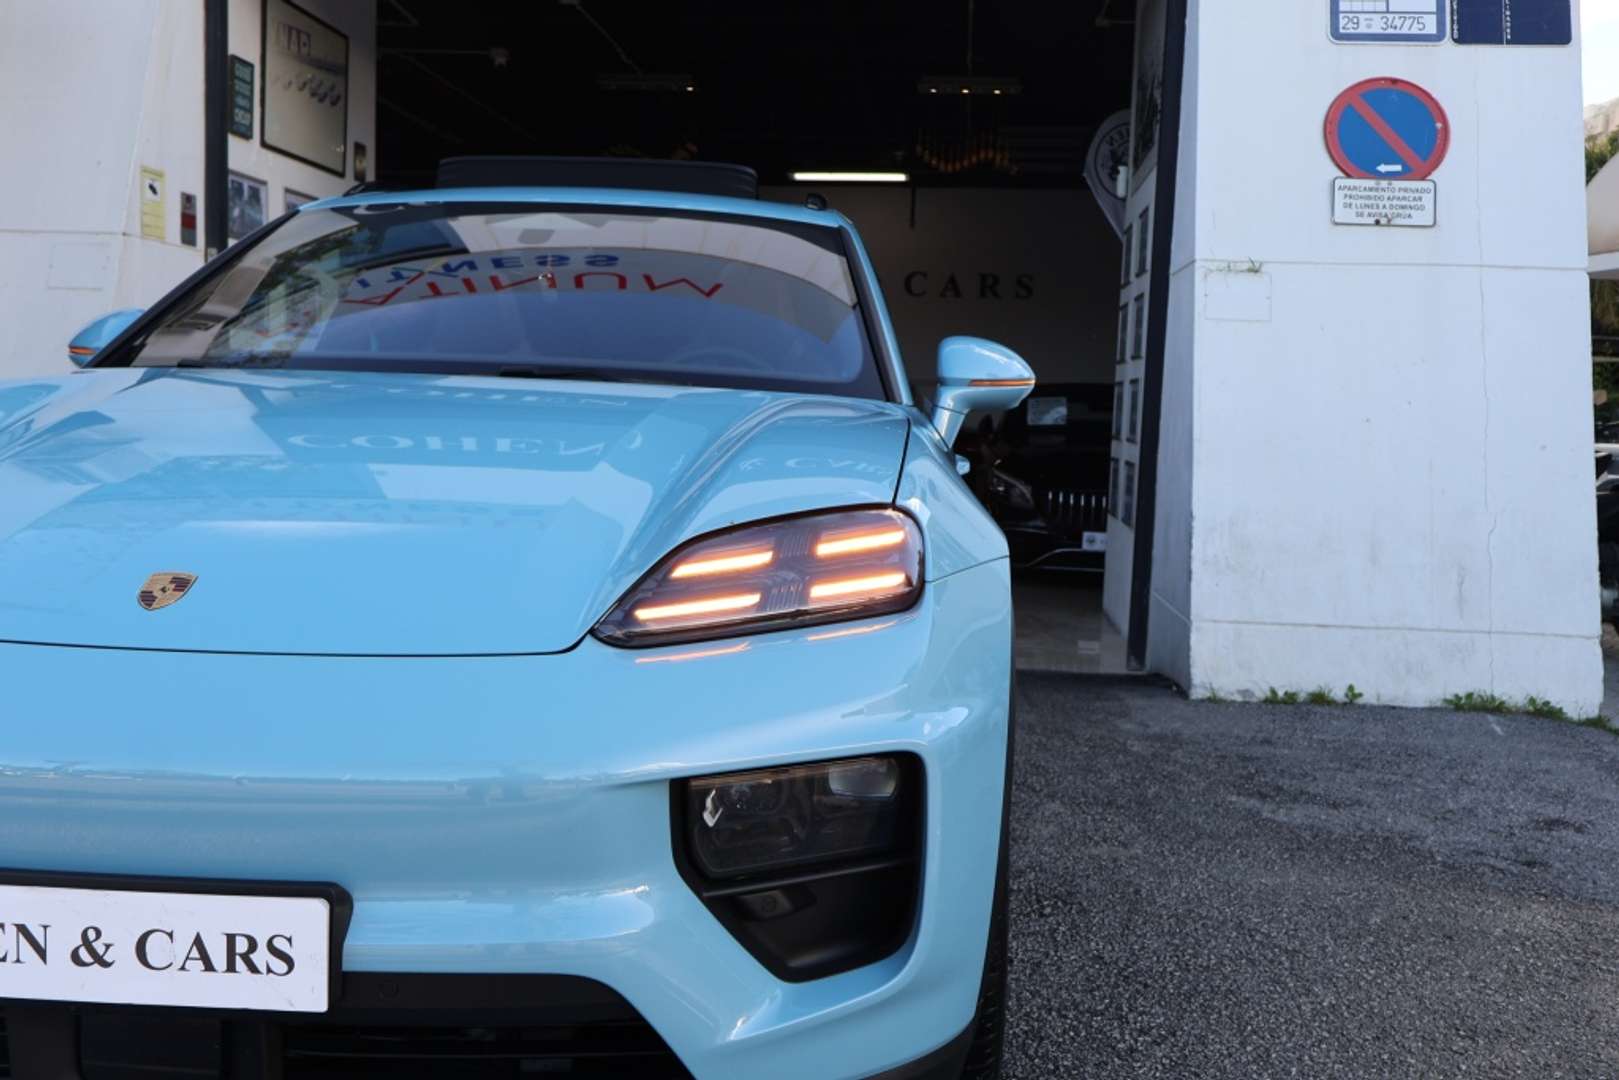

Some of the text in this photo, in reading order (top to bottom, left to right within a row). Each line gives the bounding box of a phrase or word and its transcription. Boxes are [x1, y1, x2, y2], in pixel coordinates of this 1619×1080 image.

[1341, 15, 1426, 31] 29 34775
[1337, 185, 1396, 194] APARCAMIENTO
[1343, 193, 1385, 202] PROHIBIDO
[1389, 203, 1426, 211] DOMINGO
[904, 270, 1035, 299] CARS
[0, 922, 296, 977] N & CARS
